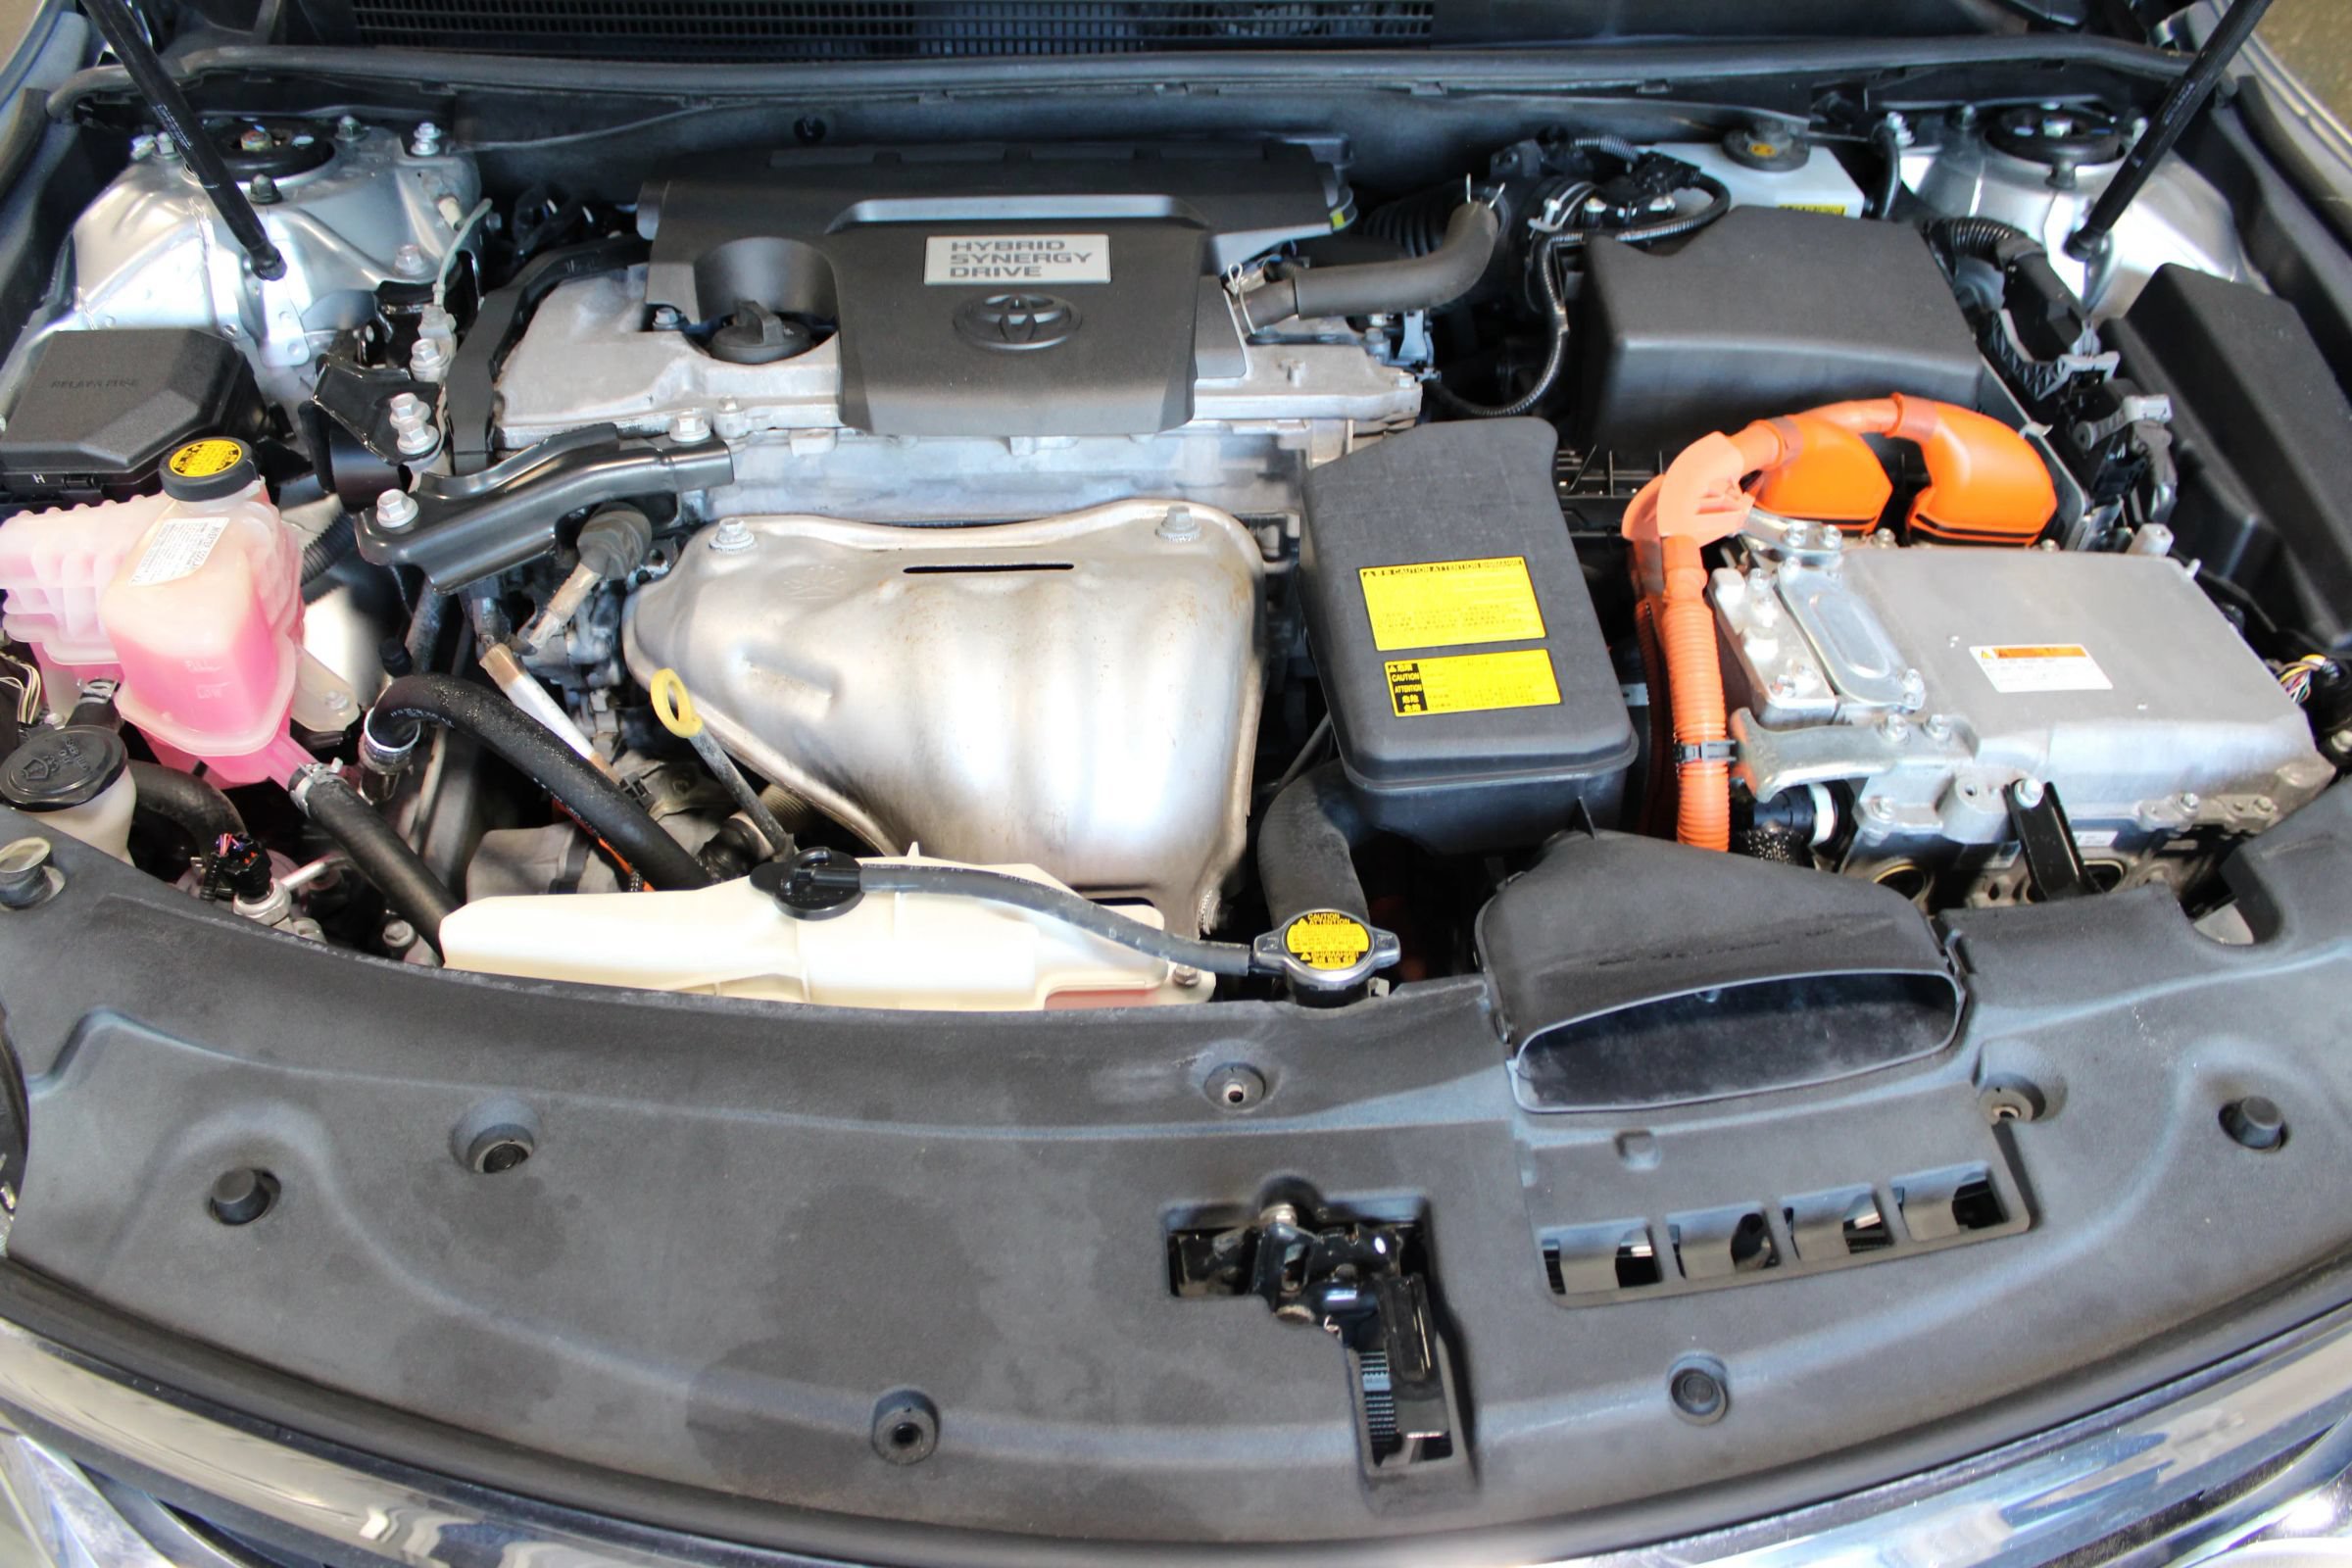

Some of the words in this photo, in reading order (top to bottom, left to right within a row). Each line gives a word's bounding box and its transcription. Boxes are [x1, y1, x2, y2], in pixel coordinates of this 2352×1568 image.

[951, 240, 1066, 252] HYBRID
[950, 252, 1093, 265] SYNERGY
[950, 266, 1042, 278] DRIVE
[1392, 672, 1420, 682] CAUTION
[1395, 684, 1423, 694] ATTENTION
